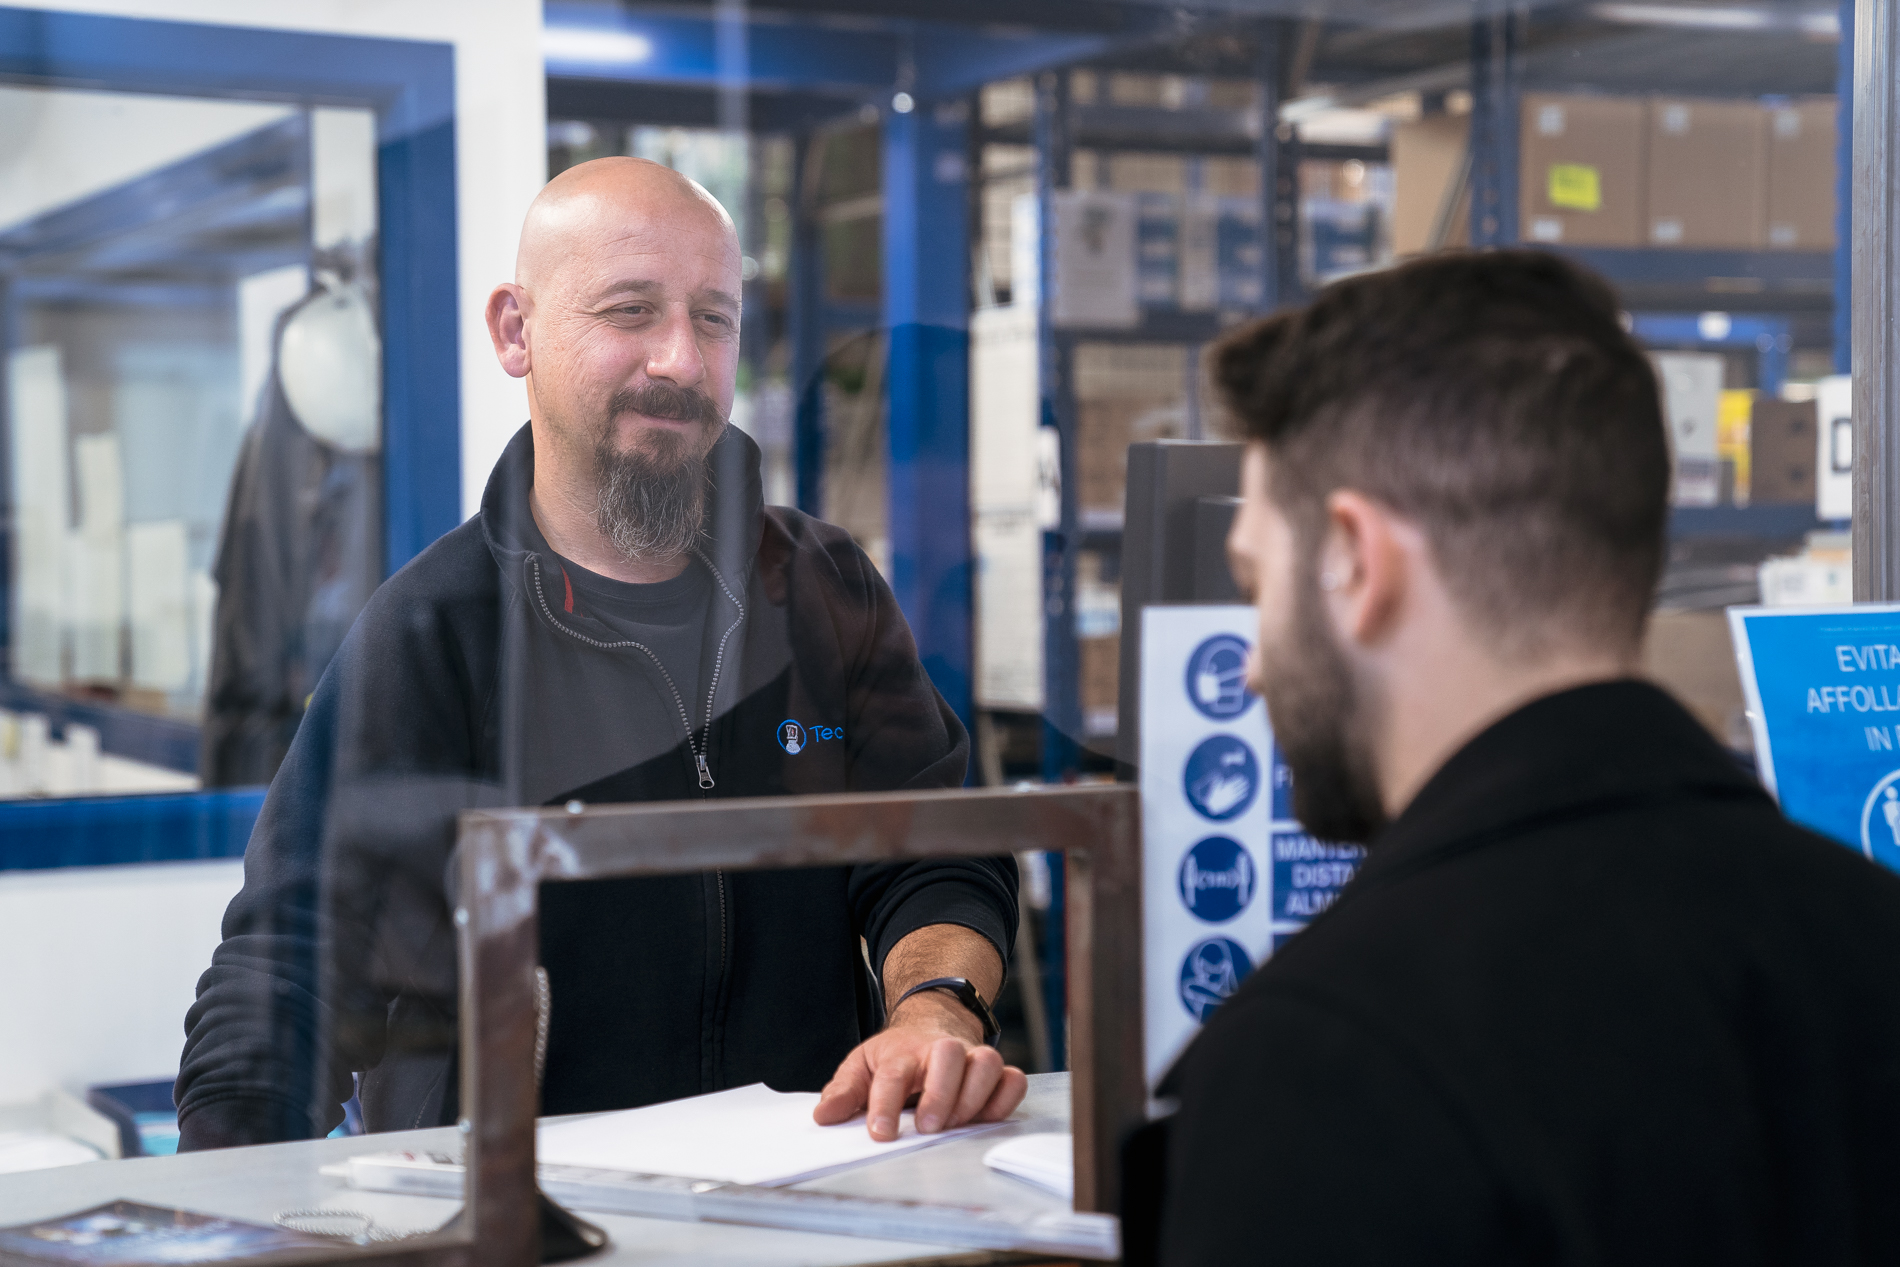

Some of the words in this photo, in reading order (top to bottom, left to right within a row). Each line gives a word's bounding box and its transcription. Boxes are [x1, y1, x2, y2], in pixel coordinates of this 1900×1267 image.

[1806, 685, 1900, 714] AFFOLL
[809, 725, 844, 742] Tec
[1864, 725, 1893, 751] IN
